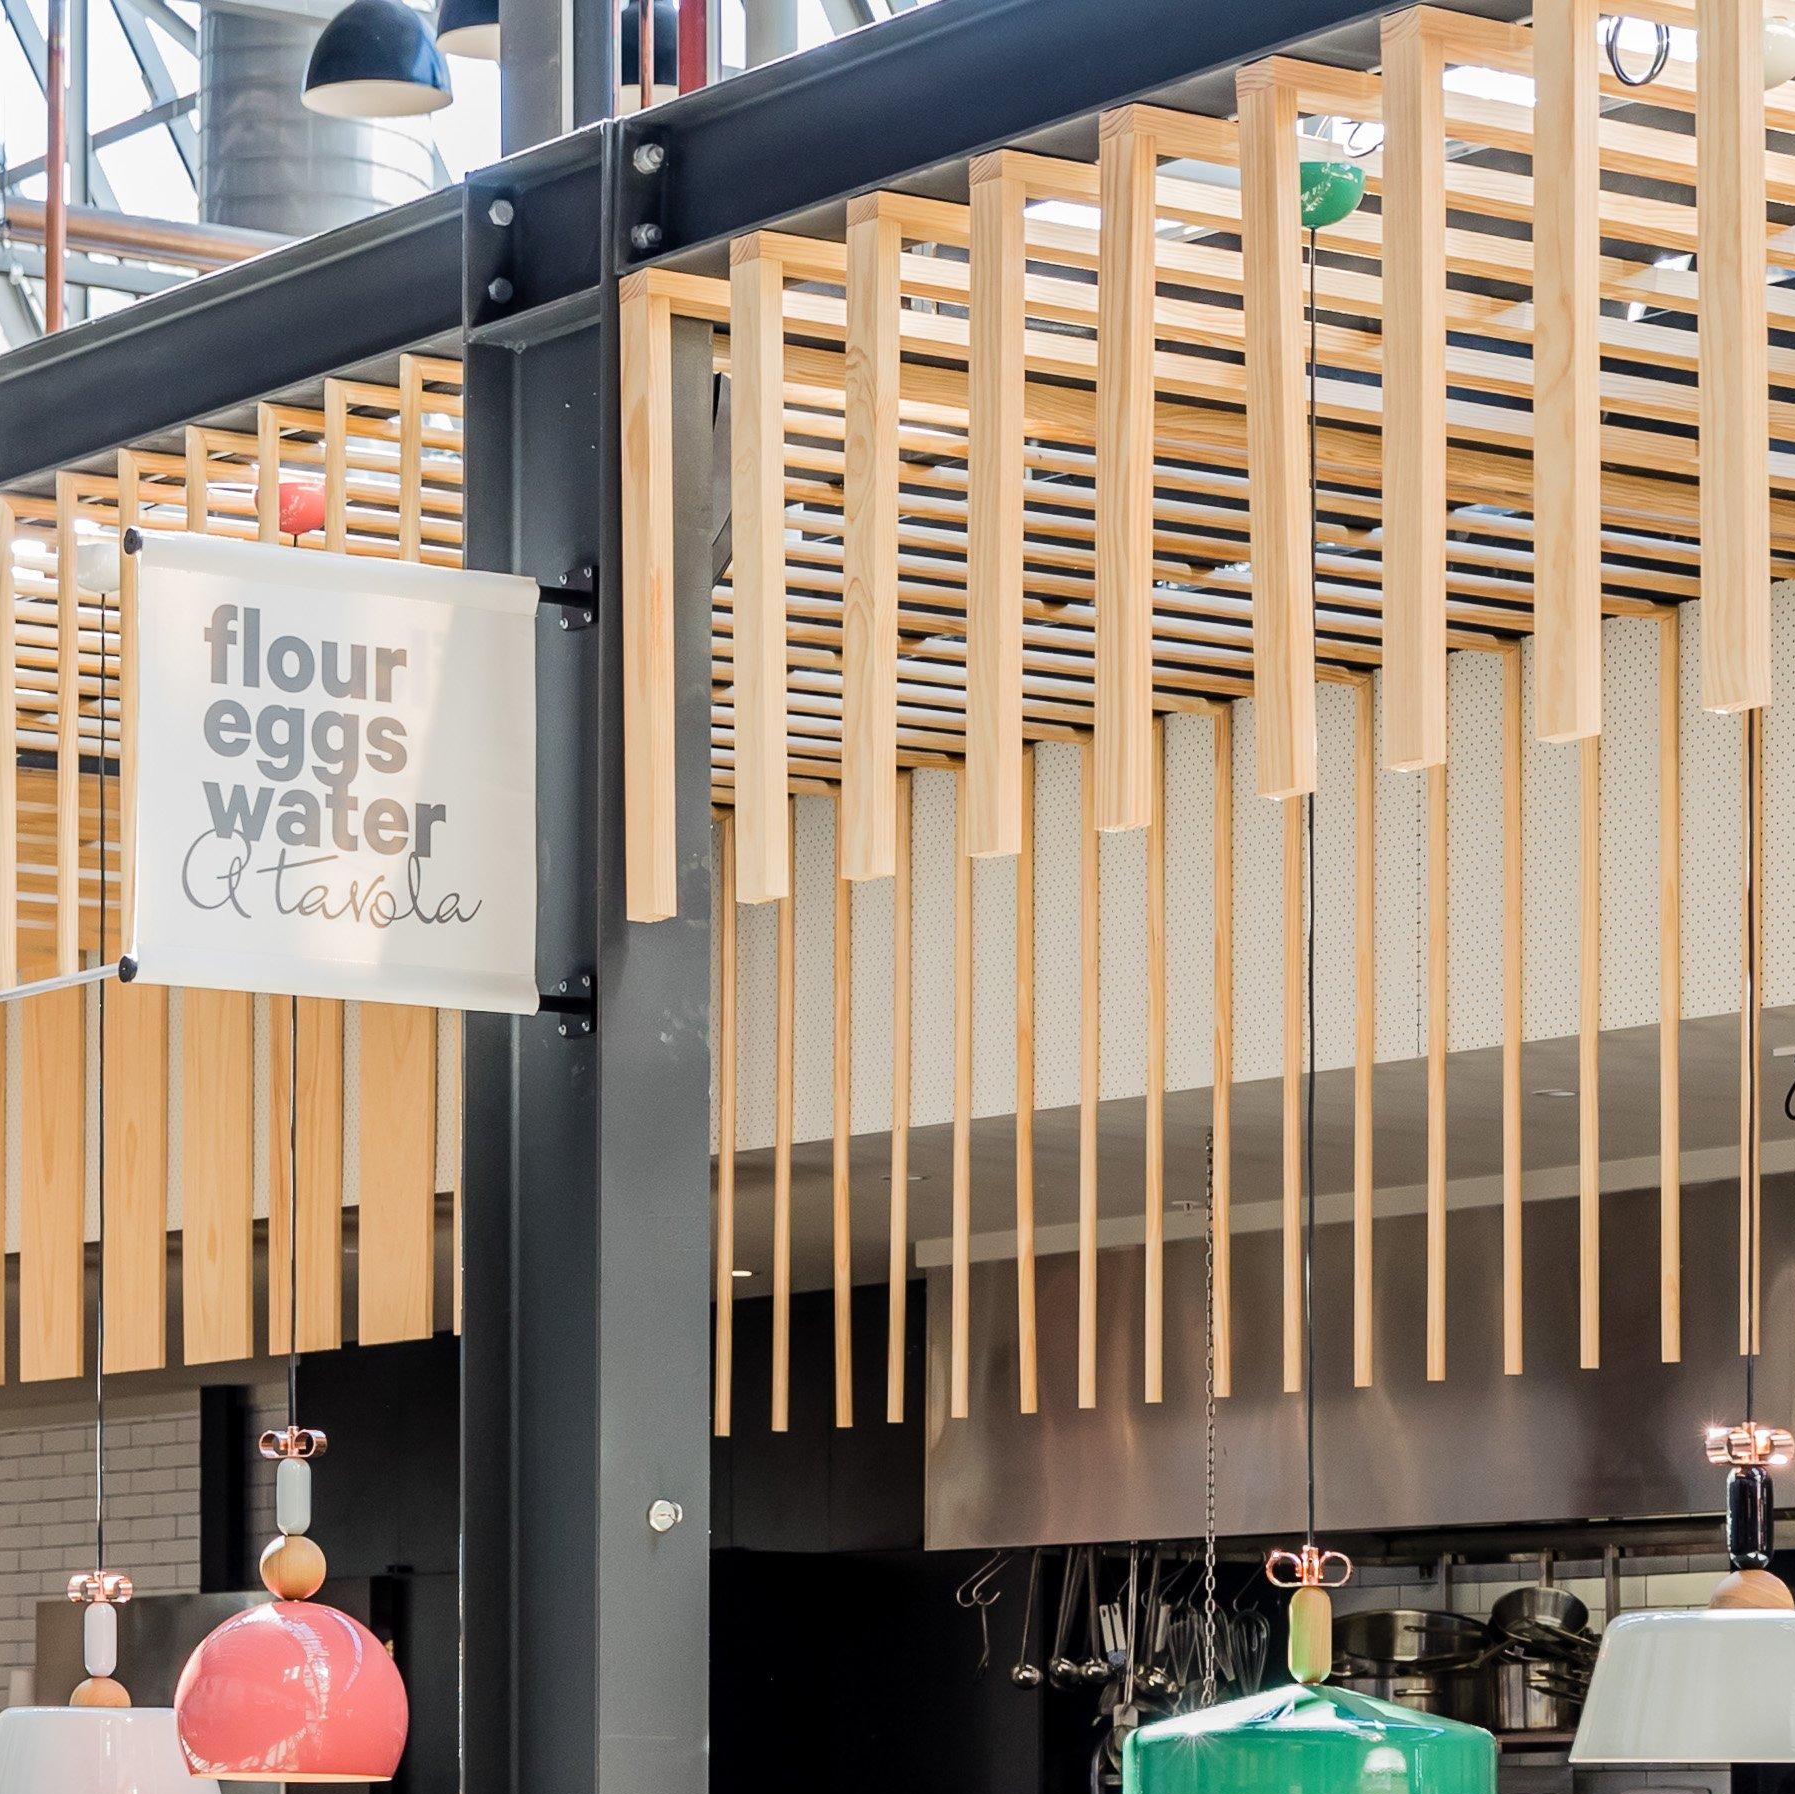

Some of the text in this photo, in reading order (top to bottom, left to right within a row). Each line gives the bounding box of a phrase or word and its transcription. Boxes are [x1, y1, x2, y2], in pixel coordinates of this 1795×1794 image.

[204, 603, 407, 702] flour
[204, 697, 407, 786] eggs
[202, 780, 447, 858] water
